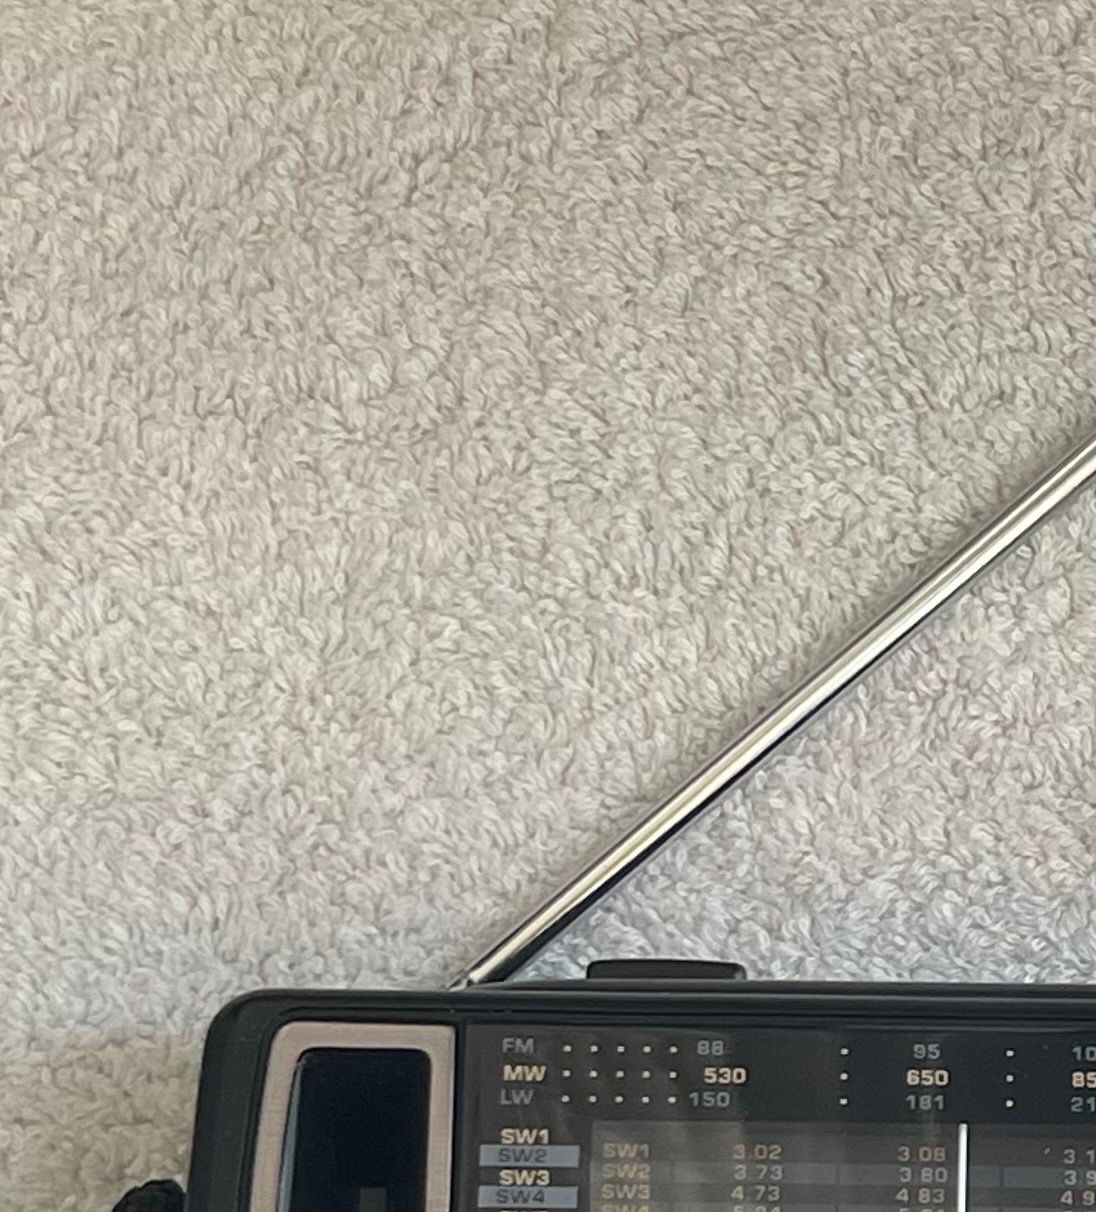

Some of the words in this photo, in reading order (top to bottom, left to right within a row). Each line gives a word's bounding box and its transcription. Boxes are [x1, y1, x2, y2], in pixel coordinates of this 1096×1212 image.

[502, 1038, 535, 1054] FM
[913, 1044, 941, 1059] 95
[503, 1065, 547, 1082] MW
[703, 1067, 747, 1084] 530
[906, 1069, 949, 1086] 650
[500, 1089, 535, 1105] LW
[689, 1092, 730, 1107] 150
[905, 1095, 944, 1110] 181
[500, 1128, 550, 1145] SW1
[498, 1149, 547, 1164] SW2
[603, 1143, 650, 1159] SW1
[500, 1169, 550, 1186] SW3
[602, 1164, 650, 1180] SW2
[496, 1190, 545, 1205] SW4
[601, 1184, 650, 1200] SW3
